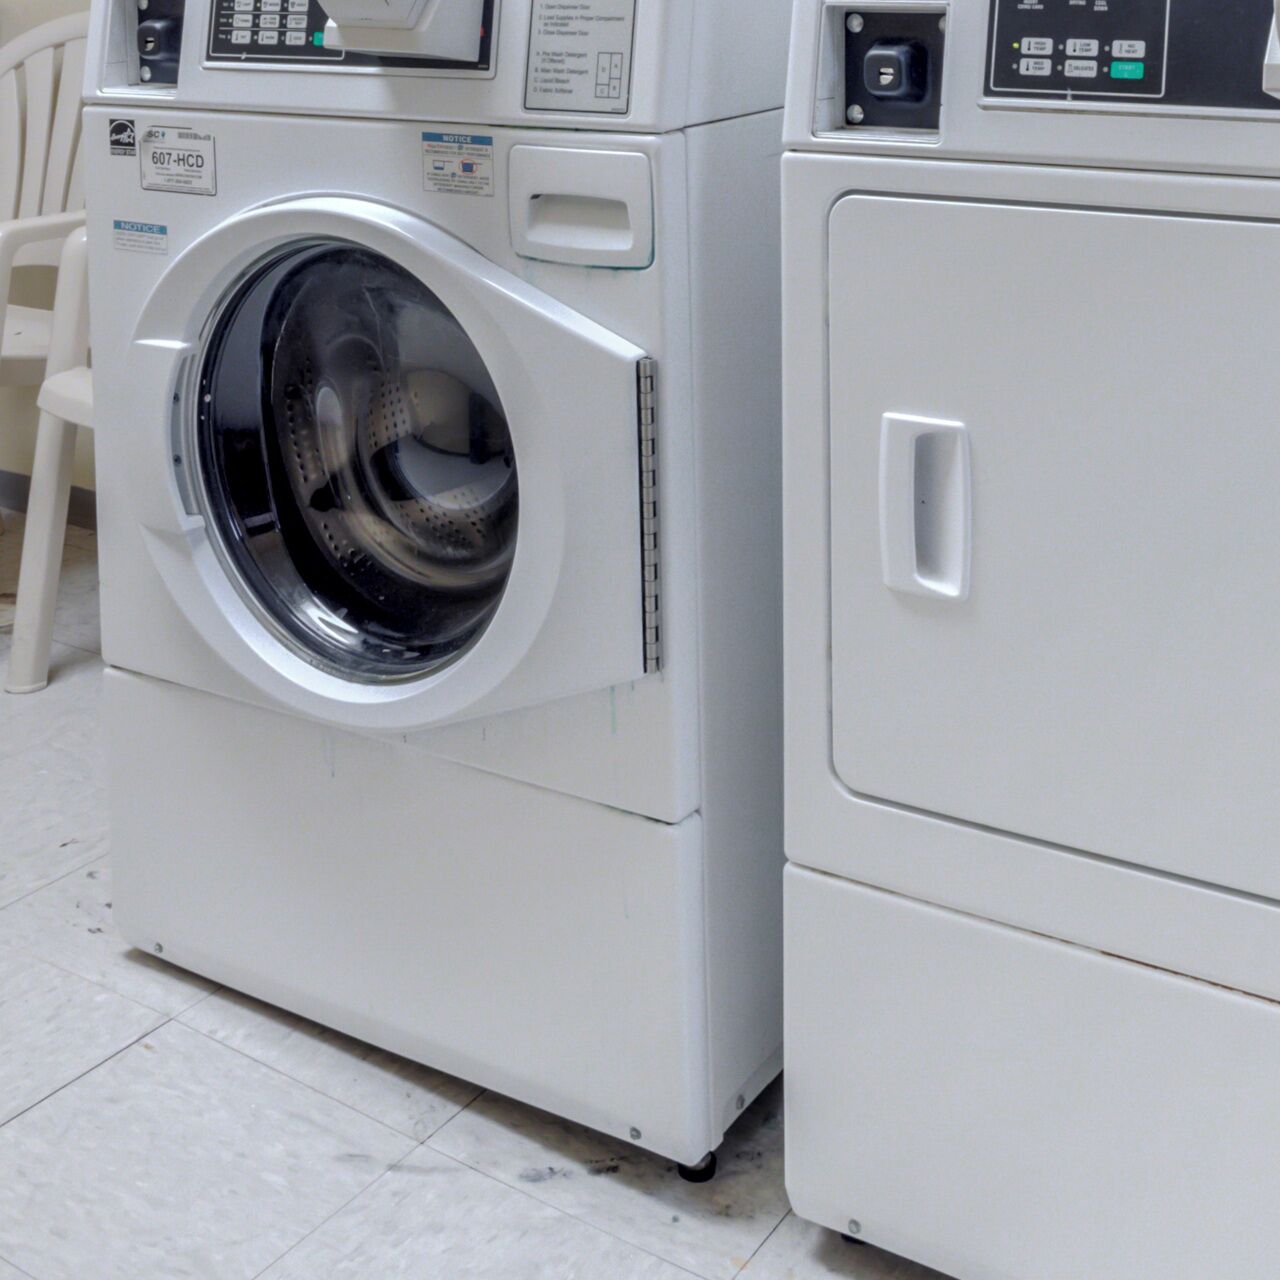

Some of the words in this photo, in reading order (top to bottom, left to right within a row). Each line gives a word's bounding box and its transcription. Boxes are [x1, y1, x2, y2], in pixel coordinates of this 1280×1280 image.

[143, 129, 160, 139] SC
[442, 134, 473, 144] NOTICE
[152, 151, 205, 168] 607-HCD
[121, 222, 160, 233] NOTICE
